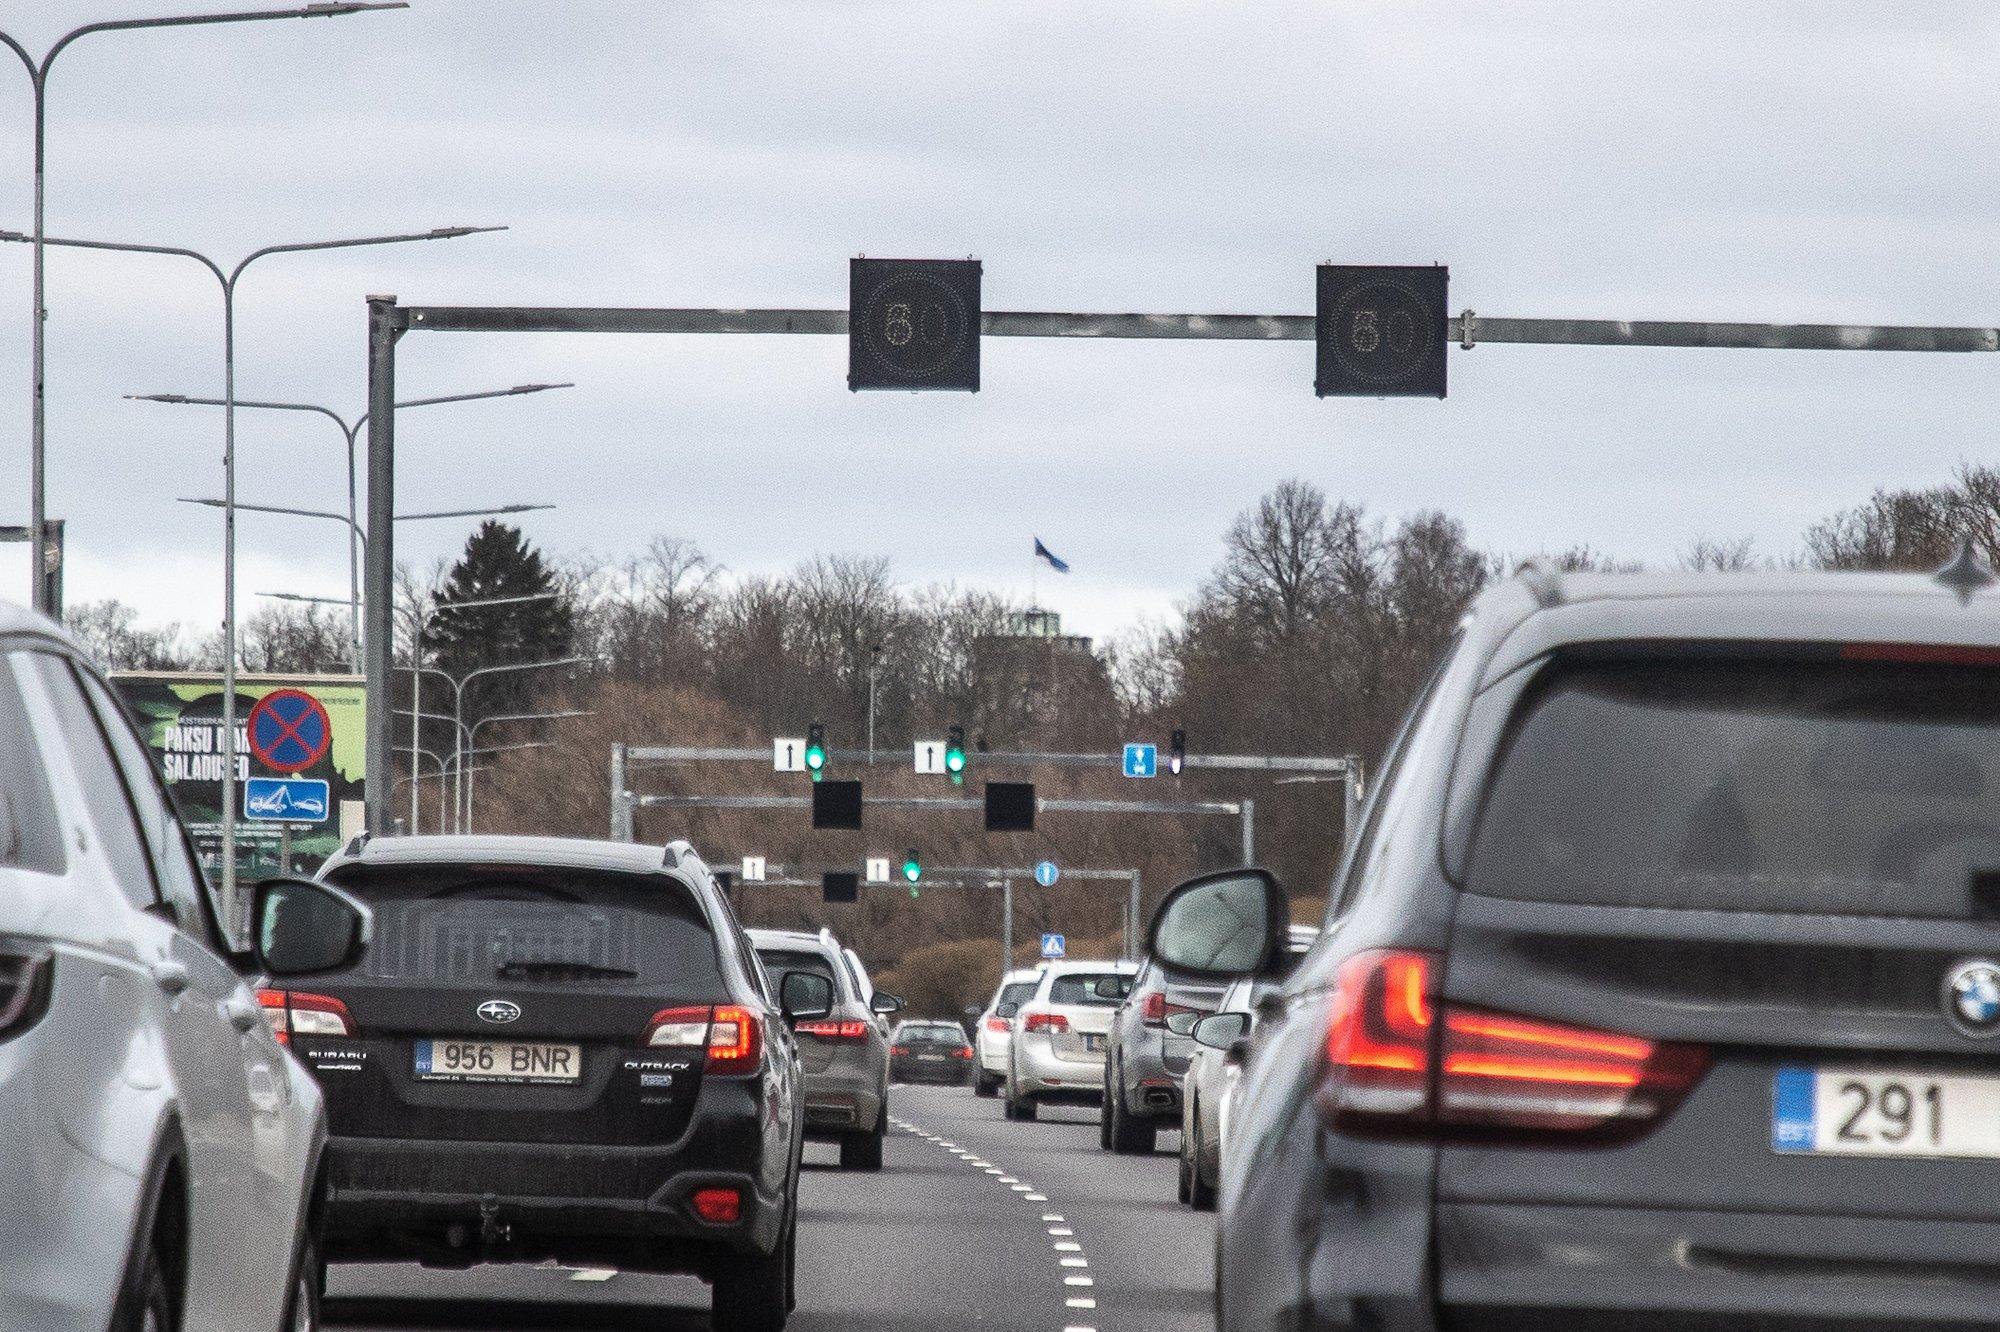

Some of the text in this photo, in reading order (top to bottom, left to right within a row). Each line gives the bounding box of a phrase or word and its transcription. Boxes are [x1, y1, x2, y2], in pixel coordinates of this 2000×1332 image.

[164, 726, 212, 753] PAKSU
[444, 1044, 571, 1074] 956 BNR
[1837, 1082, 1942, 1146] 291
